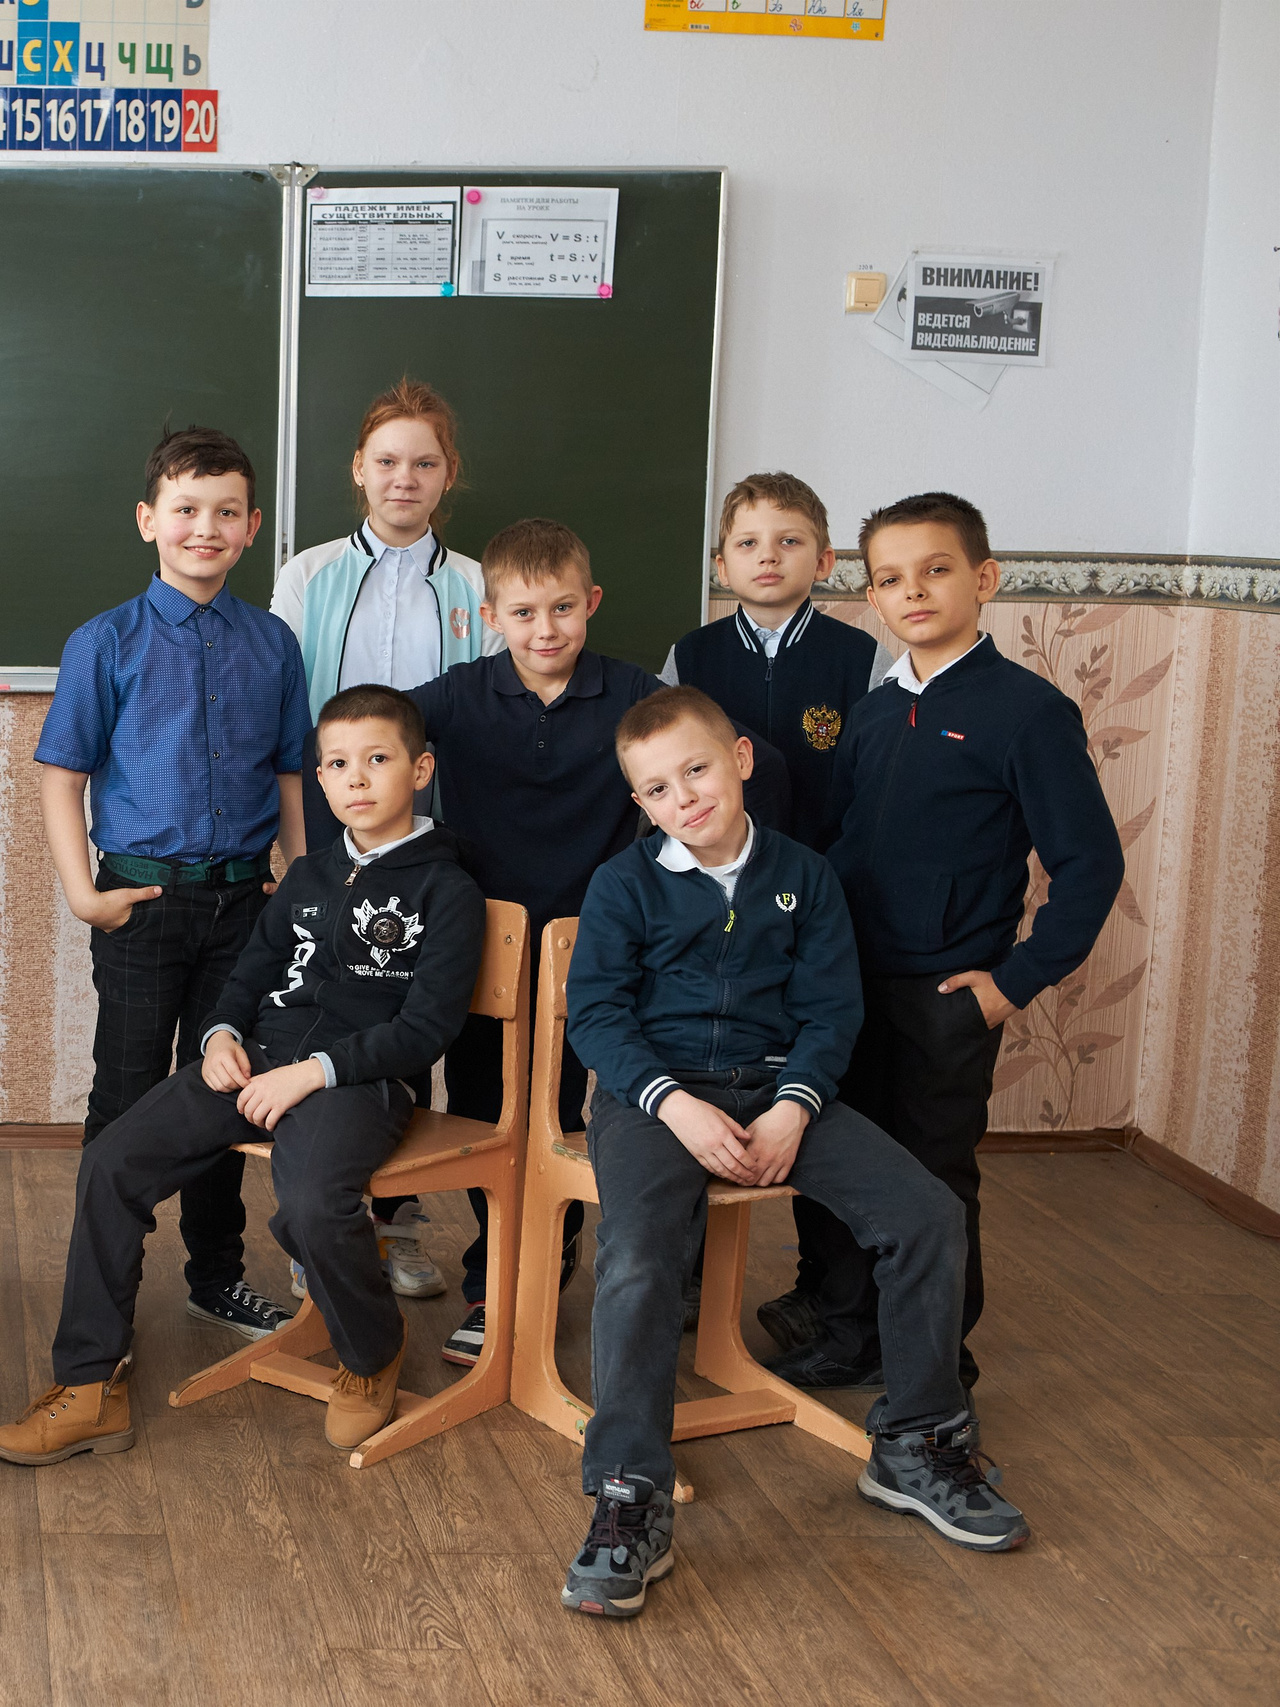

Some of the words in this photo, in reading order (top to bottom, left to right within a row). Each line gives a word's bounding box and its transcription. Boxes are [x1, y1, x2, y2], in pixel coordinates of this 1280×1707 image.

[11, 98, 41, 142] 15
[46, 98, 77, 142] 16
[80, 99, 110, 142] 17
[115, 99, 146, 142] 18
[150, 100, 180, 142] 19
[185, 100, 216, 143] 20
[496, 231, 505, 239] V
[550, 233, 559, 241] V
[574, 234, 582, 242] S
[594, 234, 598, 243] t
[550, 253, 554, 261] t
[569, 253, 577, 262] S
[589, 254, 598, 262] V
[493, 273, 502, 281] S
[549, 274, 557, 282] S
[572, 274, 581, 283] V
[593, 275, 597, 283] t
[922, 266, 1039, 291] ВНИМАНИЕ!
[918, 312, 970, 329] ВЕДЕТСЯ
[916, 332, 1036, 352] ВИДЕОНАБЛЮДЕНИЕ
